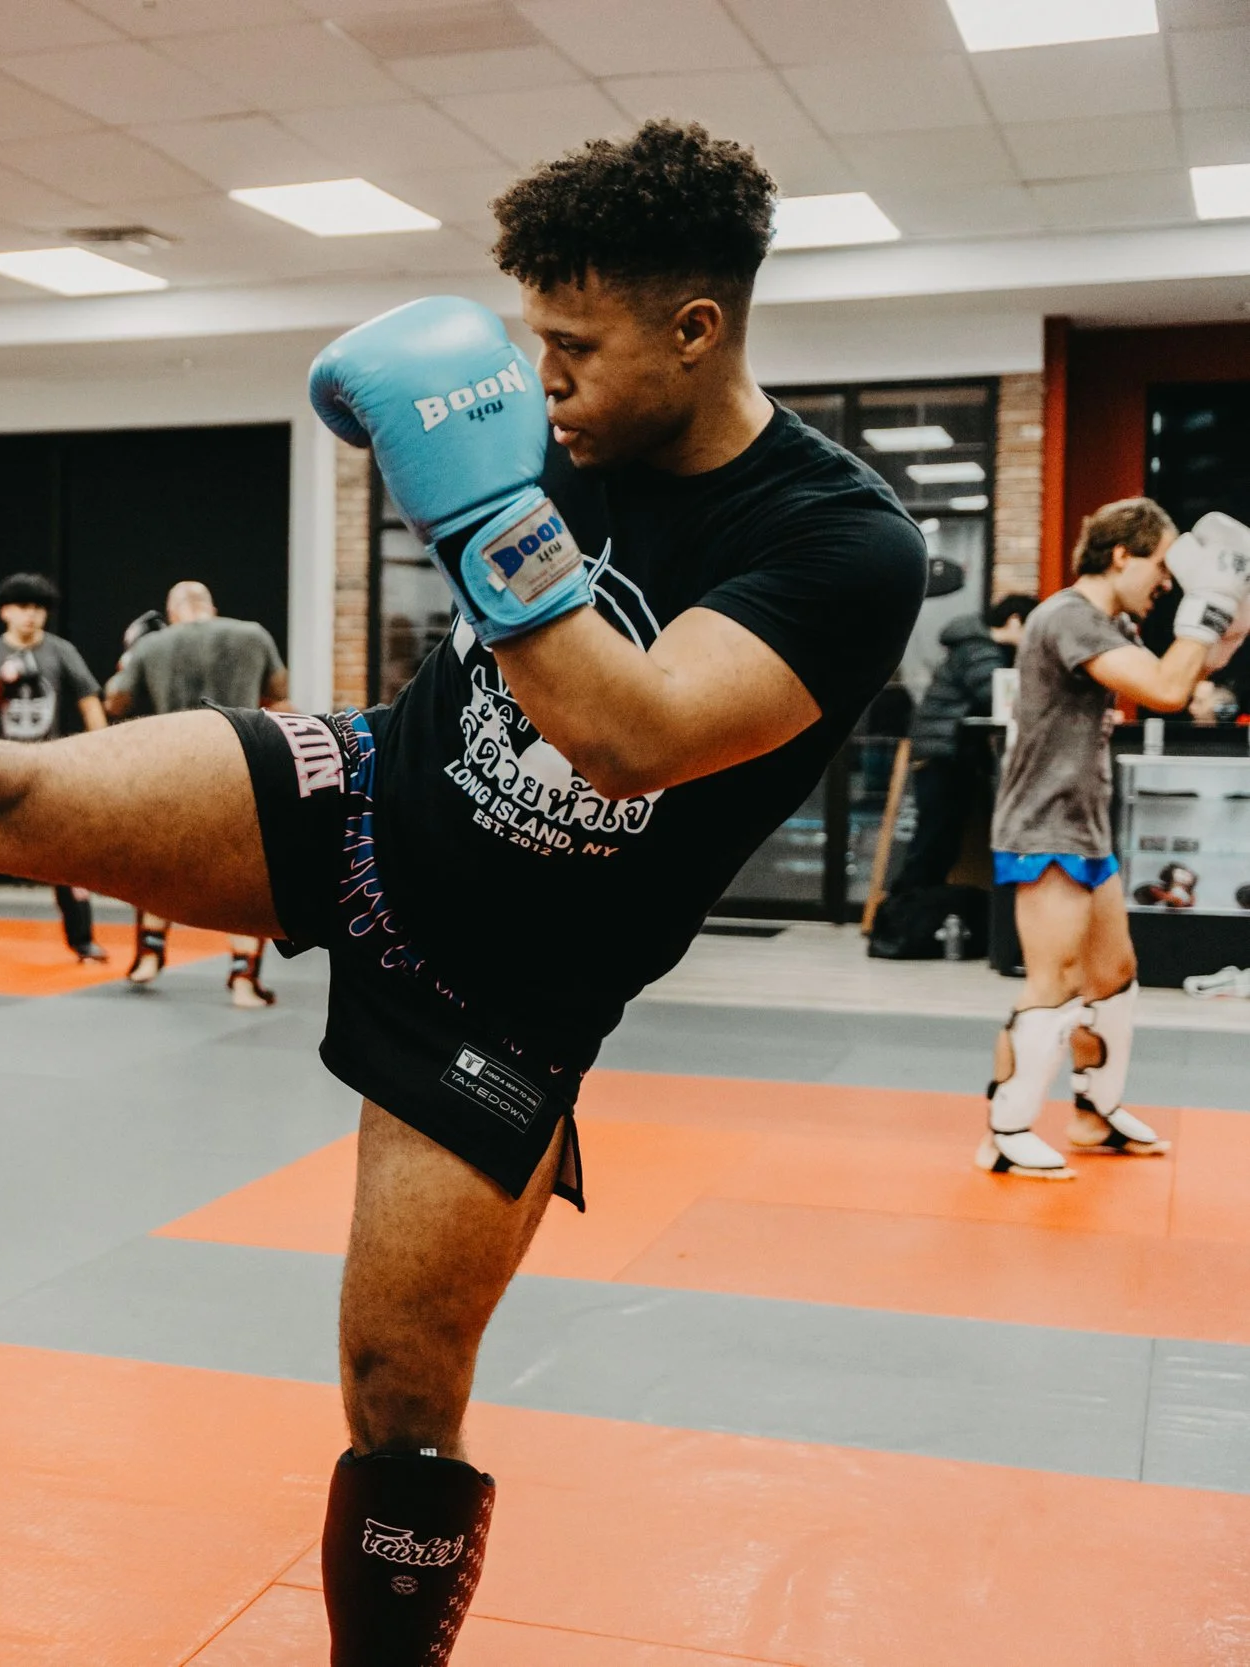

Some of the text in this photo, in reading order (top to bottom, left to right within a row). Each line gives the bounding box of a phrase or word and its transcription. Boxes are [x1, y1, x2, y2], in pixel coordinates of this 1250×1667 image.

[413, 360, 526, 432] BOON
[443, 759, 620, 858] LONG ISLAND, NY
[472, 808, 553, 857] EST. 2012
[451, 1070, 529, 1125] TAKEDOWN
[361, 1518, 465, 1567] Fairtex
